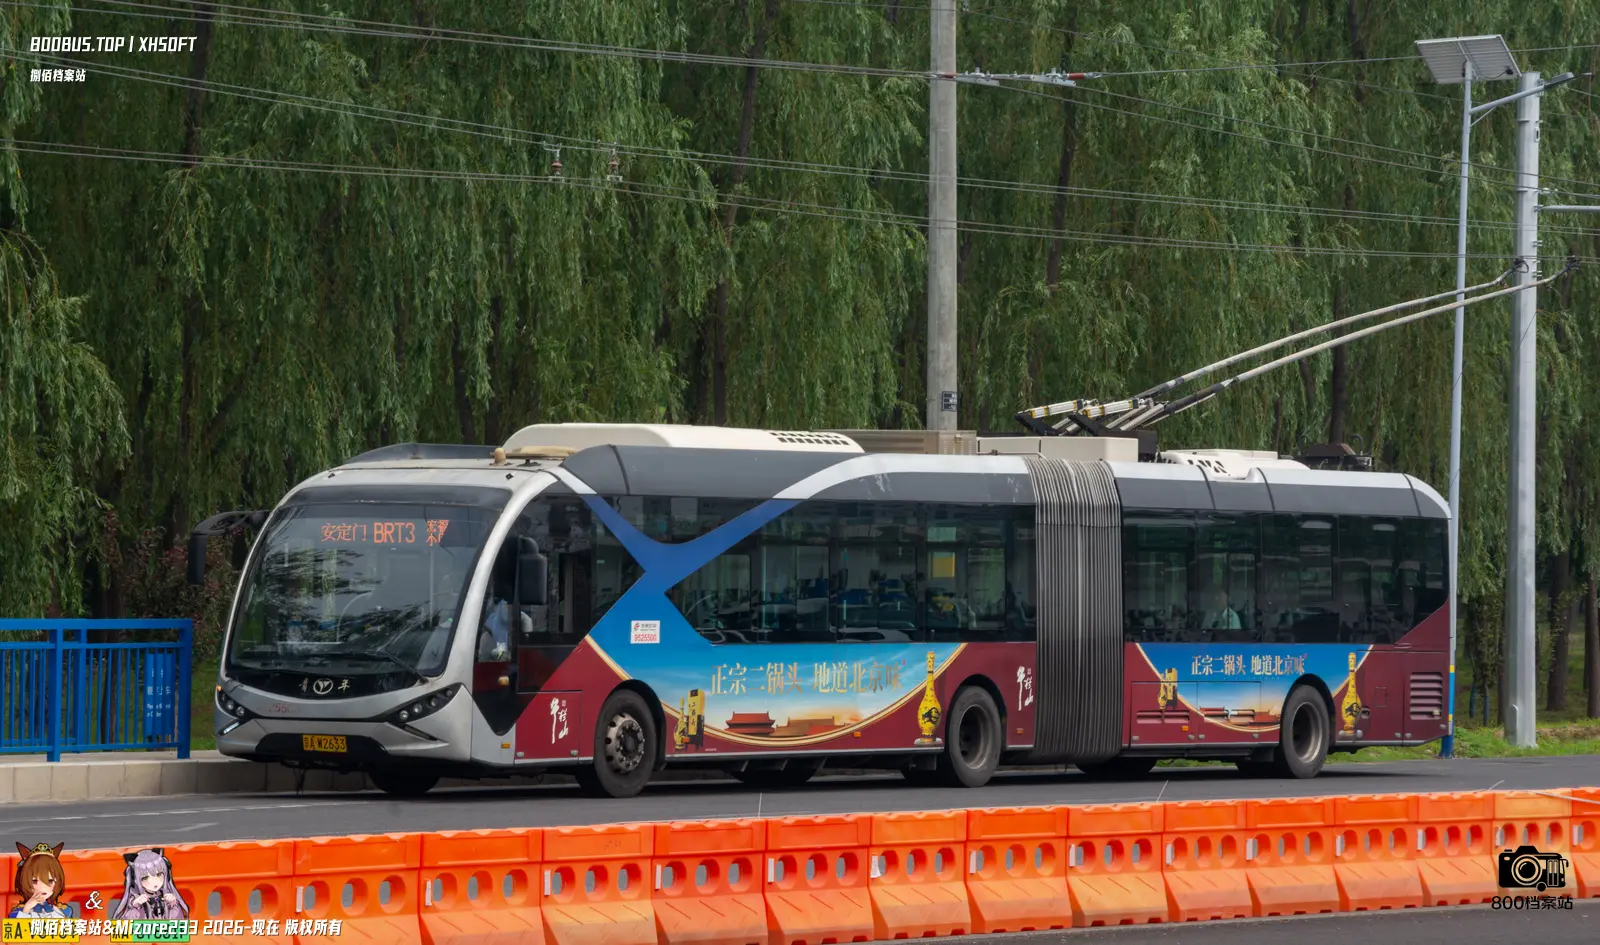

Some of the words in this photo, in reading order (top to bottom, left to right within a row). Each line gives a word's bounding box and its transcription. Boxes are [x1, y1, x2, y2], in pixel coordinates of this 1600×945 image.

[320, 523, 367, 542] 安定门
[373, 522, 415, 544] BRT3
[1191, 654, 1247, 676] 正宗二锅头
[1251, 654, 1305, 676] 地道北京味
[709, 662, 803, 696] 正宗二锅头
[812, 660, 903, 694] 地道北京味
